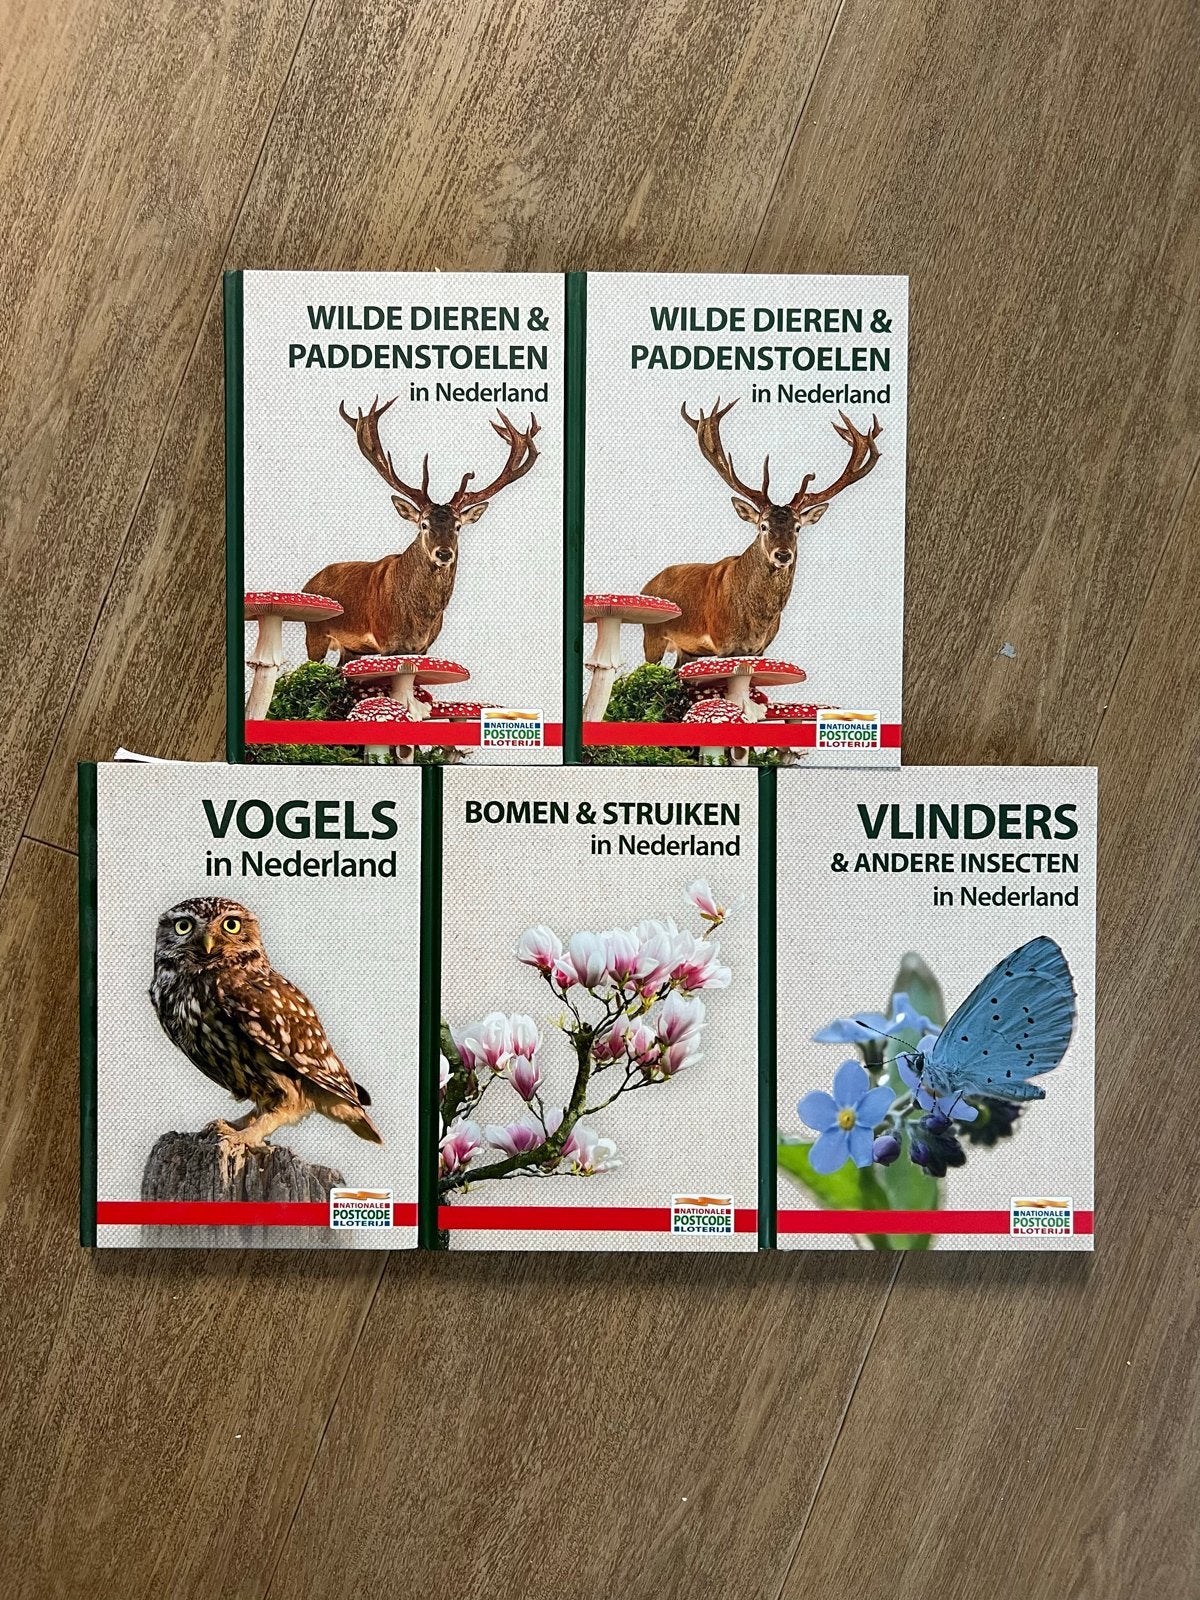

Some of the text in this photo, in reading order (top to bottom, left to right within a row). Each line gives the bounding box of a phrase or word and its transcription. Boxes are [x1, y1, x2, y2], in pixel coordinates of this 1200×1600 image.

[307, 305, 550, 332] WILDE DIEREN &
[649, 306, 893, 334] WILDE DIEREN &
[289, 343, 548, 370] PADDENSTOELEN
[631, 344, 891, 372] PADDENSTOELEN
[410, 381, 549, 403] in Nederland
[752, 383, 891, 404] in Nederland
[484, 729, 541, 740] POSTCODE
[819, 730, 877, 741] POSTCODE
[201, 799, 398, 841] VOGELS
[465, 800, 741, 826] BOMEN & STRUIKEN
[857, 803, 1079, 840] VLINDERS
[591, 834, 741, 856] in Nederland
[206, 849, 397, 878] in Nederland
[830, 852, 1079, 873] & ANDERE INSECTEN
[933, 885, 1079, 907] in Nederland
[333, 1209, 390, 1220] POSTCODE
[674, 1215, 731, 1226] POSTCODE
[1013, 1217, 1070, 1228] POSTCODE
